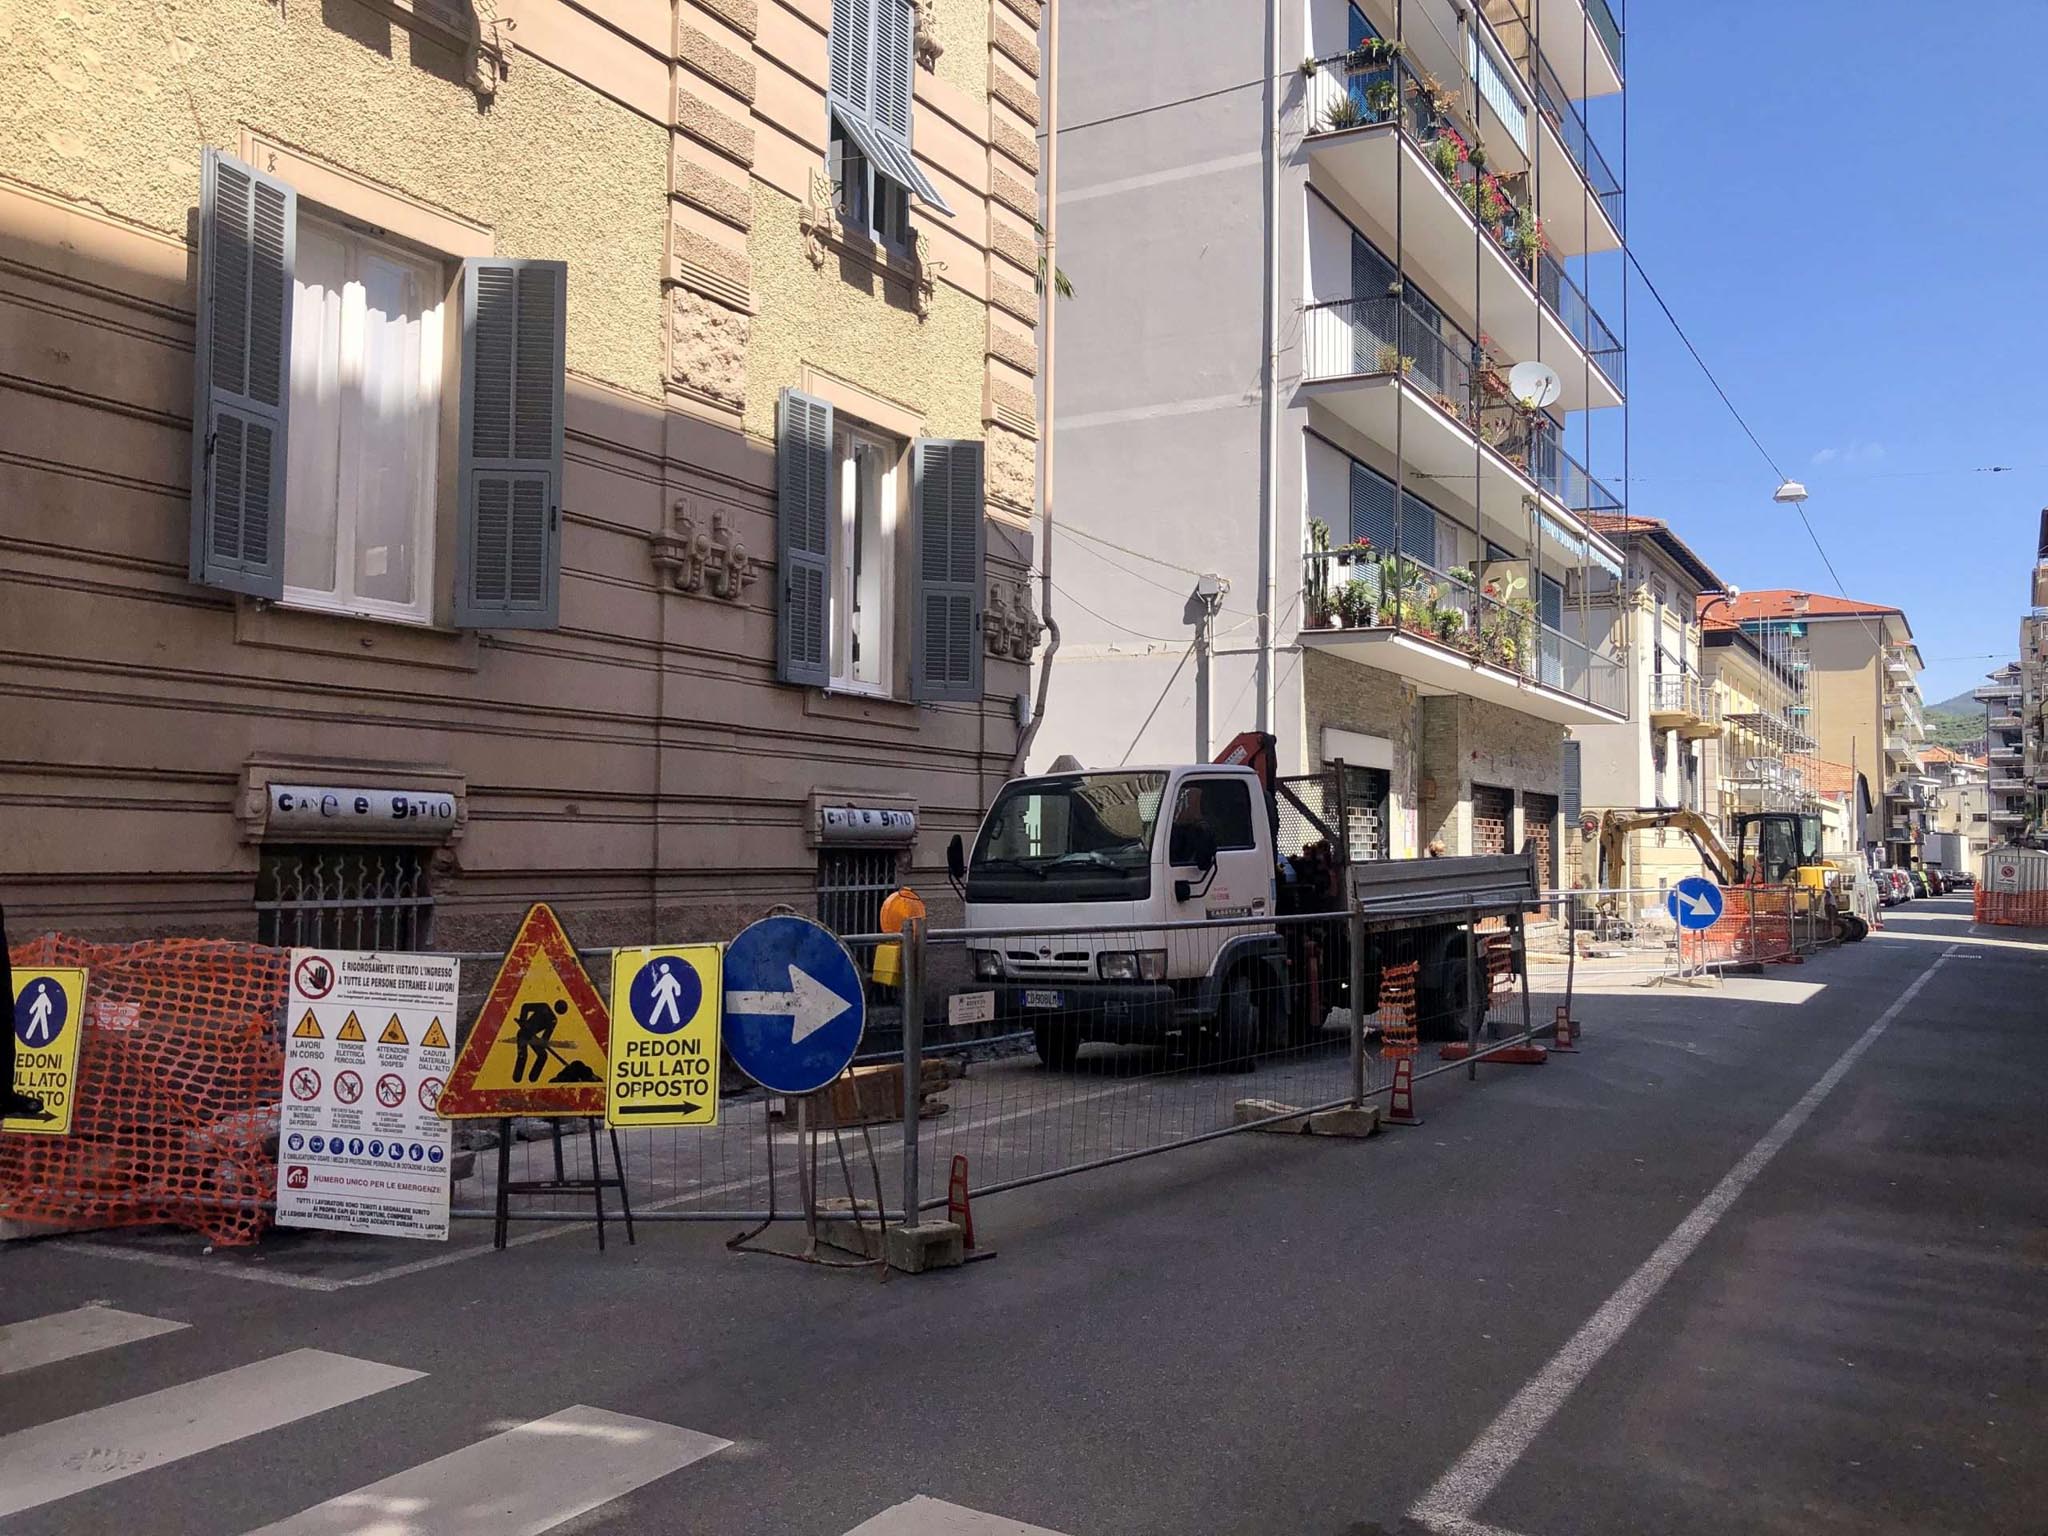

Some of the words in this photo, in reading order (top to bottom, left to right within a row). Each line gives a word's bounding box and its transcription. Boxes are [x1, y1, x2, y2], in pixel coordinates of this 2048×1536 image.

[354, 797, 369, 814] e
[347, 962, 394, 974] RIGOROSAMENTE
[396, 965, 419, 975] VIETATO
[420, 966, 453, 977] L'INGRESSO
[338, 976, 342, 985] A
[344, 976, 361, 987] TUTTE
[363, 978, 369, 987] LE
[371, 978, 396, 989] PERSONE
[398, 980, 427, 990] ESTRANEE
[428, 981, 434, 991] AI
[435, 982, 455, 992] LAVORI
[295, 1040, 321, 1049] LAVORI
[338, 1043, 363, 1051] TENSIONE
[627, 1039, 700, 1057] PEDONI
[336, 1050, 364, 1058] ELETTRICA
[377, 1046, 409, 1054] ATTENZIONE
[290, 1050, 298, 1058] IN
[299, 1050, 325, 1060] CORSO
[16, 1053, 62, 1069] EDONI
[334, 1057, 365, 1065] PERICOLOSA
[381, 1060, 403, 1068] SOSPESI
[420, 1057, 450, 1065] MATERIALI
[419, 1064, 450, 1072] DALL'ALTO
[617, 1060, 654, 1078] SUL
[660, 1058, 710, 1077] LATO
[29, 1072, 67, 1088] LATO
[615, 1079, 708, 1098] OPPOSTO
[295, 1174, 307, 1185] 112
[314, 1175, 344, 1185] NUMERO
[347, 1178, 369, 1187] UNICO
[370, 1180, 384, 1189] PER
[387, 1182, 396, 1190] LE
[397, 1183, 441, 1193] EMERGENZE
[315, 1199, 344, 1207] LAVORATORI
[425, 1223, 445, 1231] LAVORO
